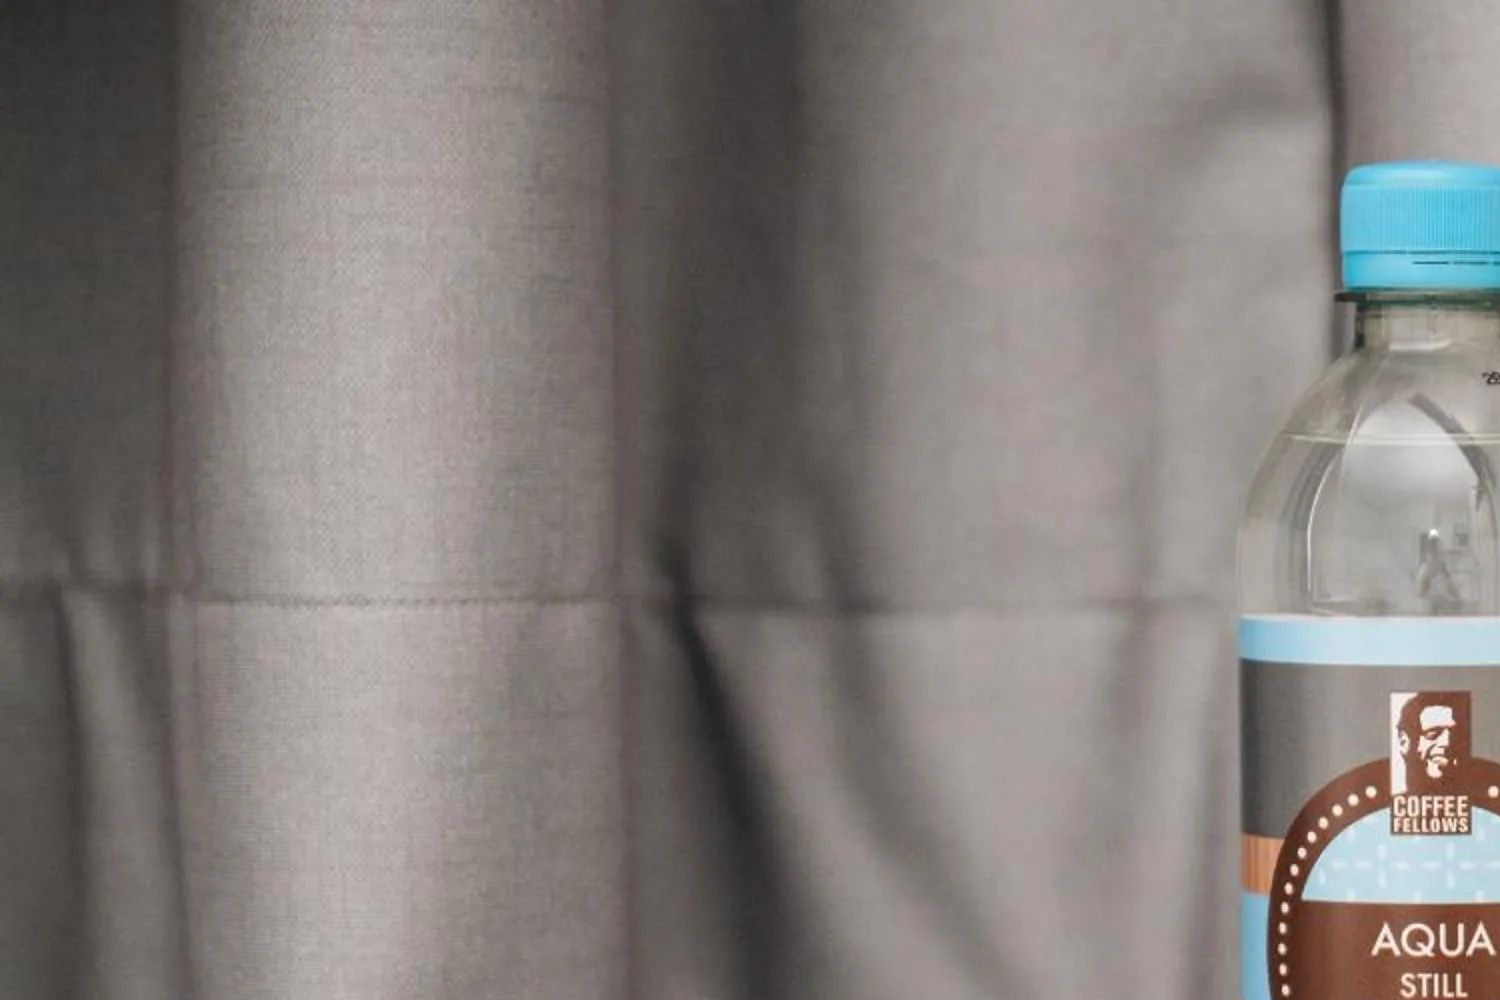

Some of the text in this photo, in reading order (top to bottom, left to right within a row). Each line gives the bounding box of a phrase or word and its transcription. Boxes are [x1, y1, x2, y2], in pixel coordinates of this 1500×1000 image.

[1393, 796, 1469, 817] COFFEE
[1393, 818, 1469, 833] FELLOWS
[1371, 922, 1497, 957] AQUA
[1400, 972, 1468, 999] STILL
